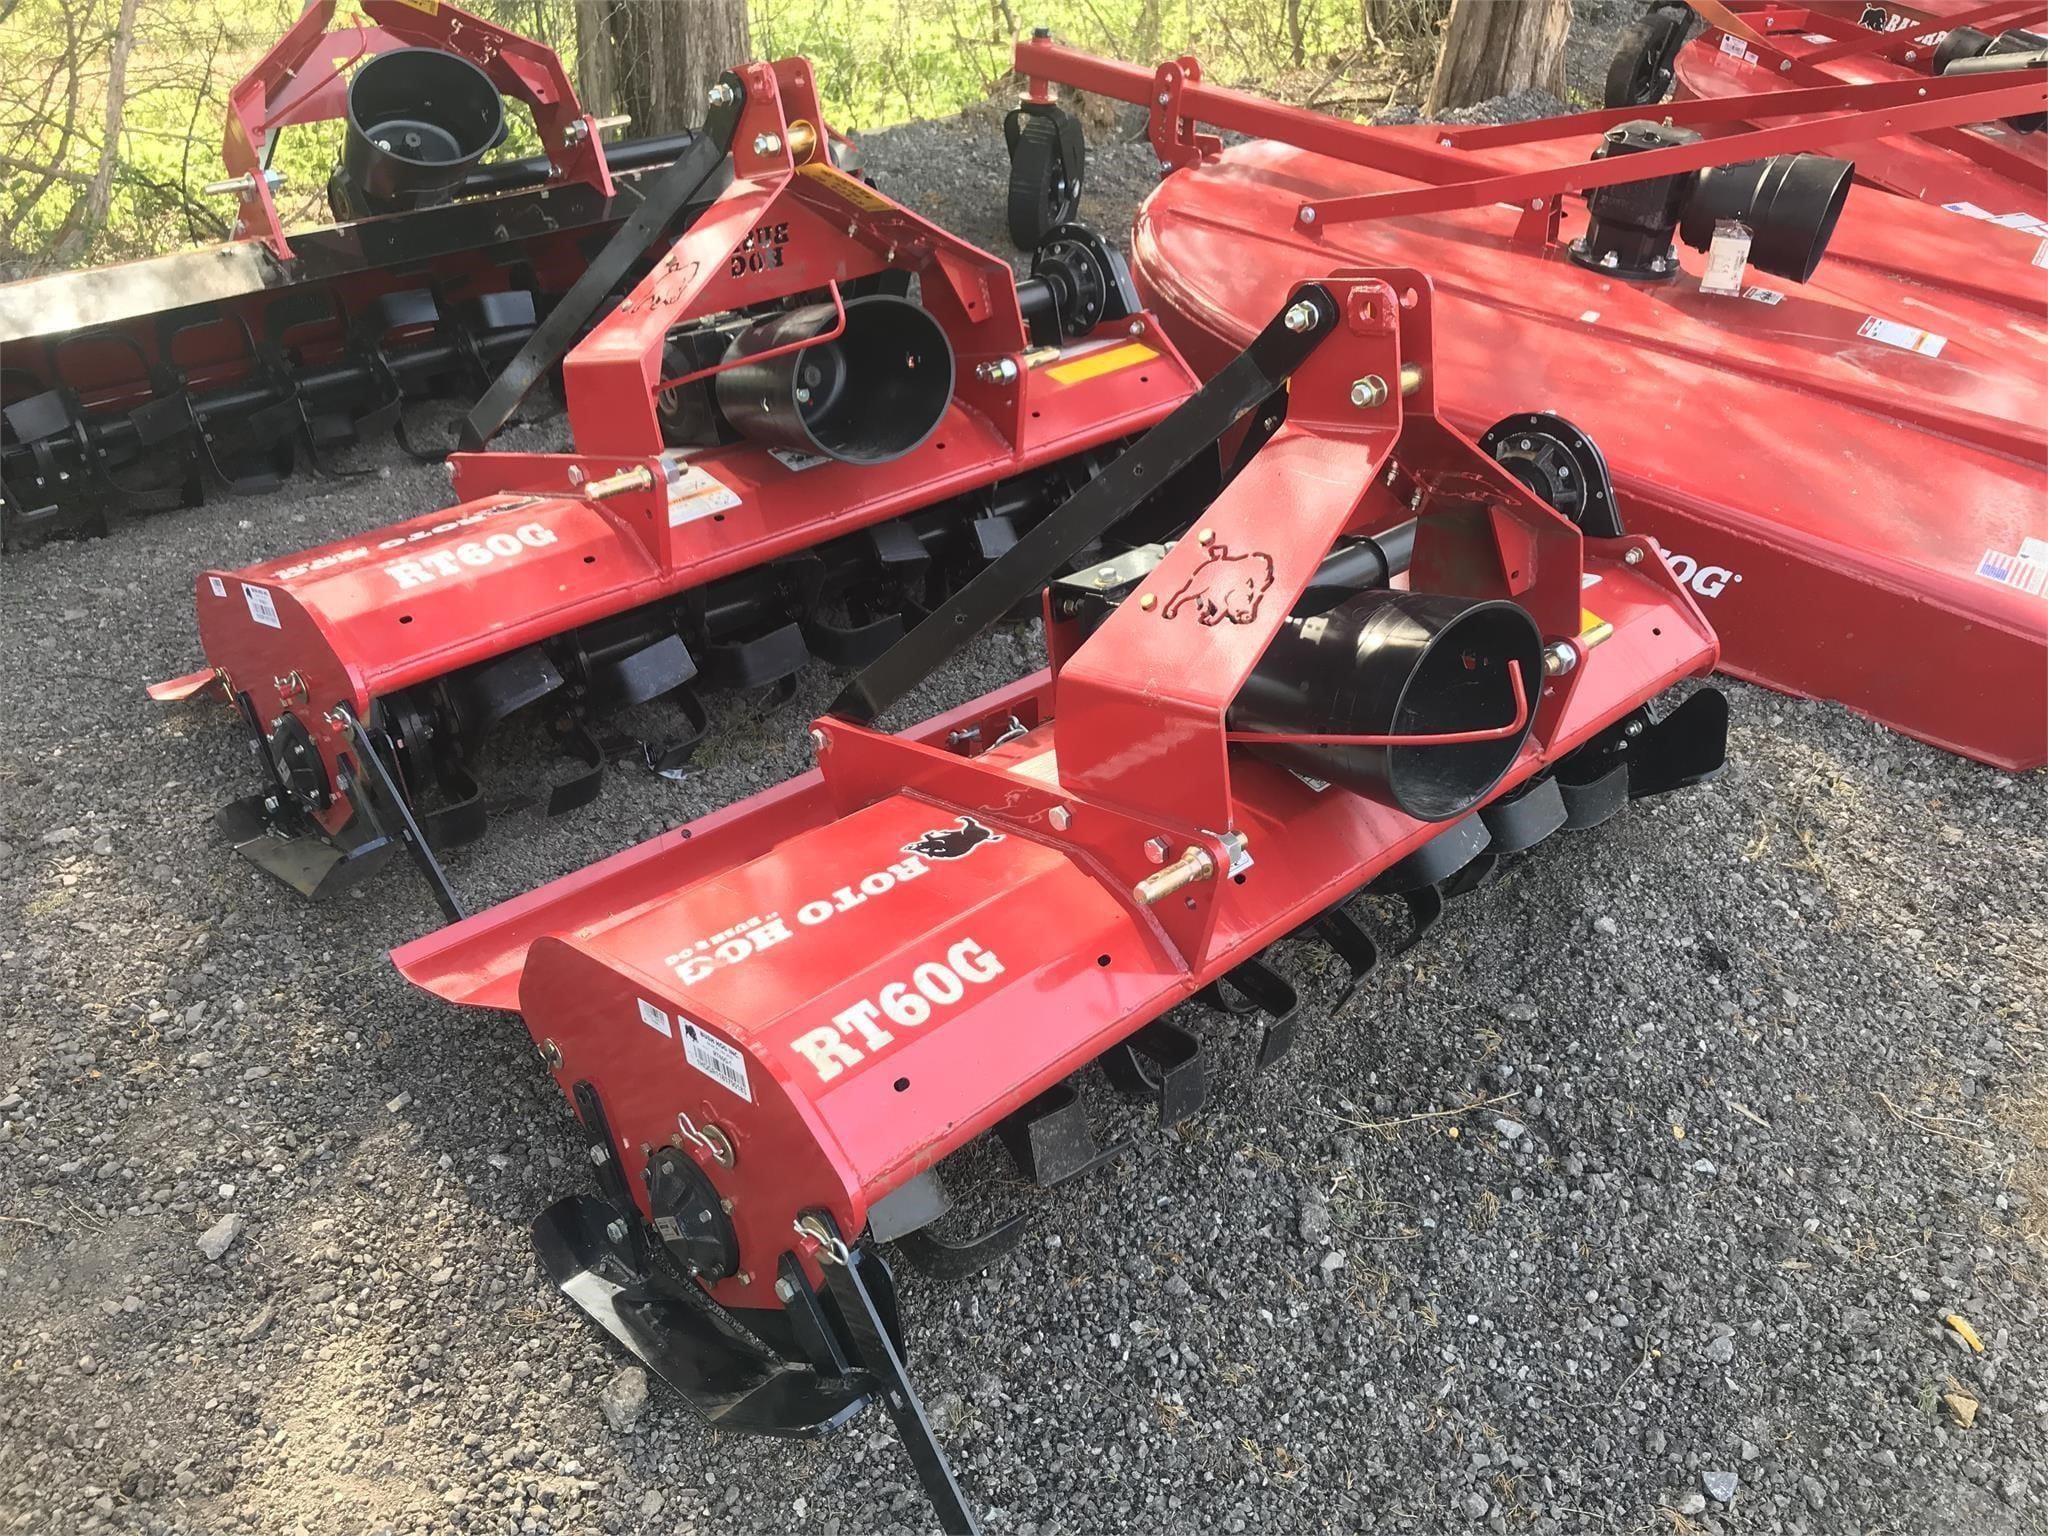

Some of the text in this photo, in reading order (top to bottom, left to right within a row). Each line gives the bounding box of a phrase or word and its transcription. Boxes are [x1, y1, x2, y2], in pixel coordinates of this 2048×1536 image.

[384, 523, 558, 590] RT60G
[674, 856, 930, 987] ROTO HOG
[709, 916, 762, 945] BUSH
[790, 937, 1006, 1083] RT60G
